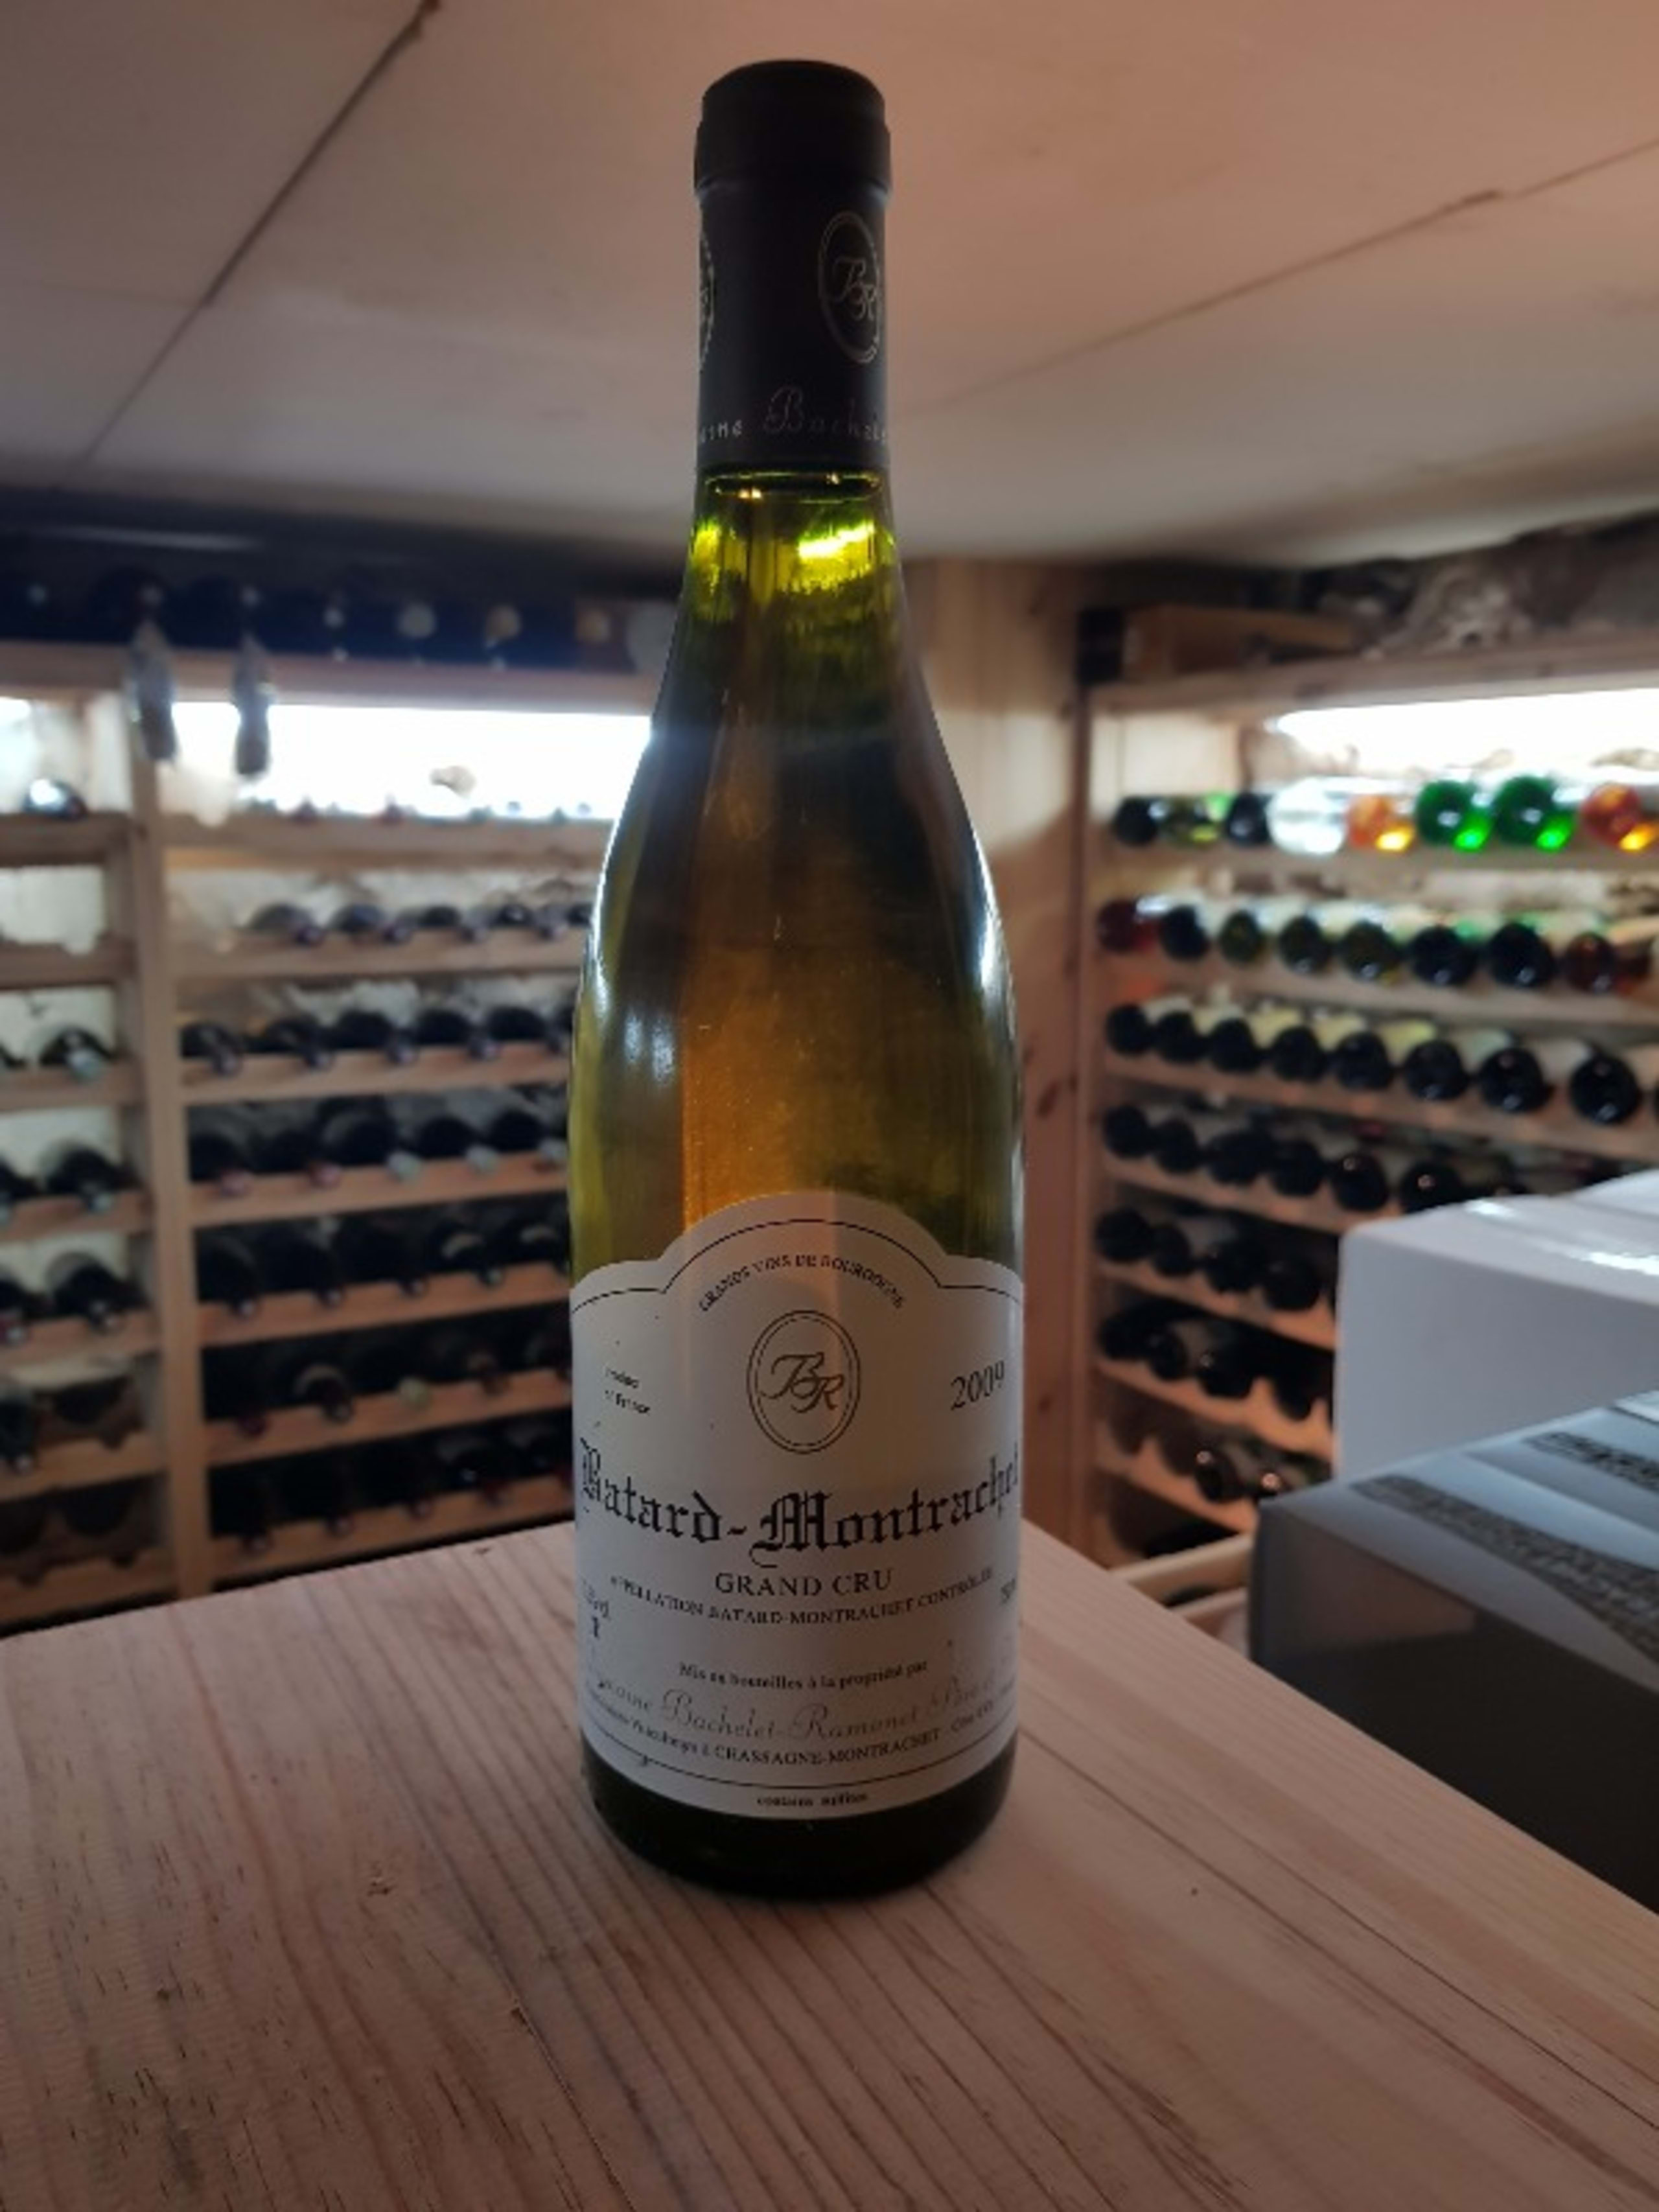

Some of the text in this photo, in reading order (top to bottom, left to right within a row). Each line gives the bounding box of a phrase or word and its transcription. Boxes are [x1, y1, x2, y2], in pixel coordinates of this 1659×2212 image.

[699, 1264, 750, 1312] GRANDS
[752, 1255, 792, 1273] VINS
[796, 1255, 817, 1267] DE
[950, 1360, 1004, 1411] 2009
[715, 1567, 893, 1596] GRAND CRU
[679, 1661, 706, 1681] Mis
